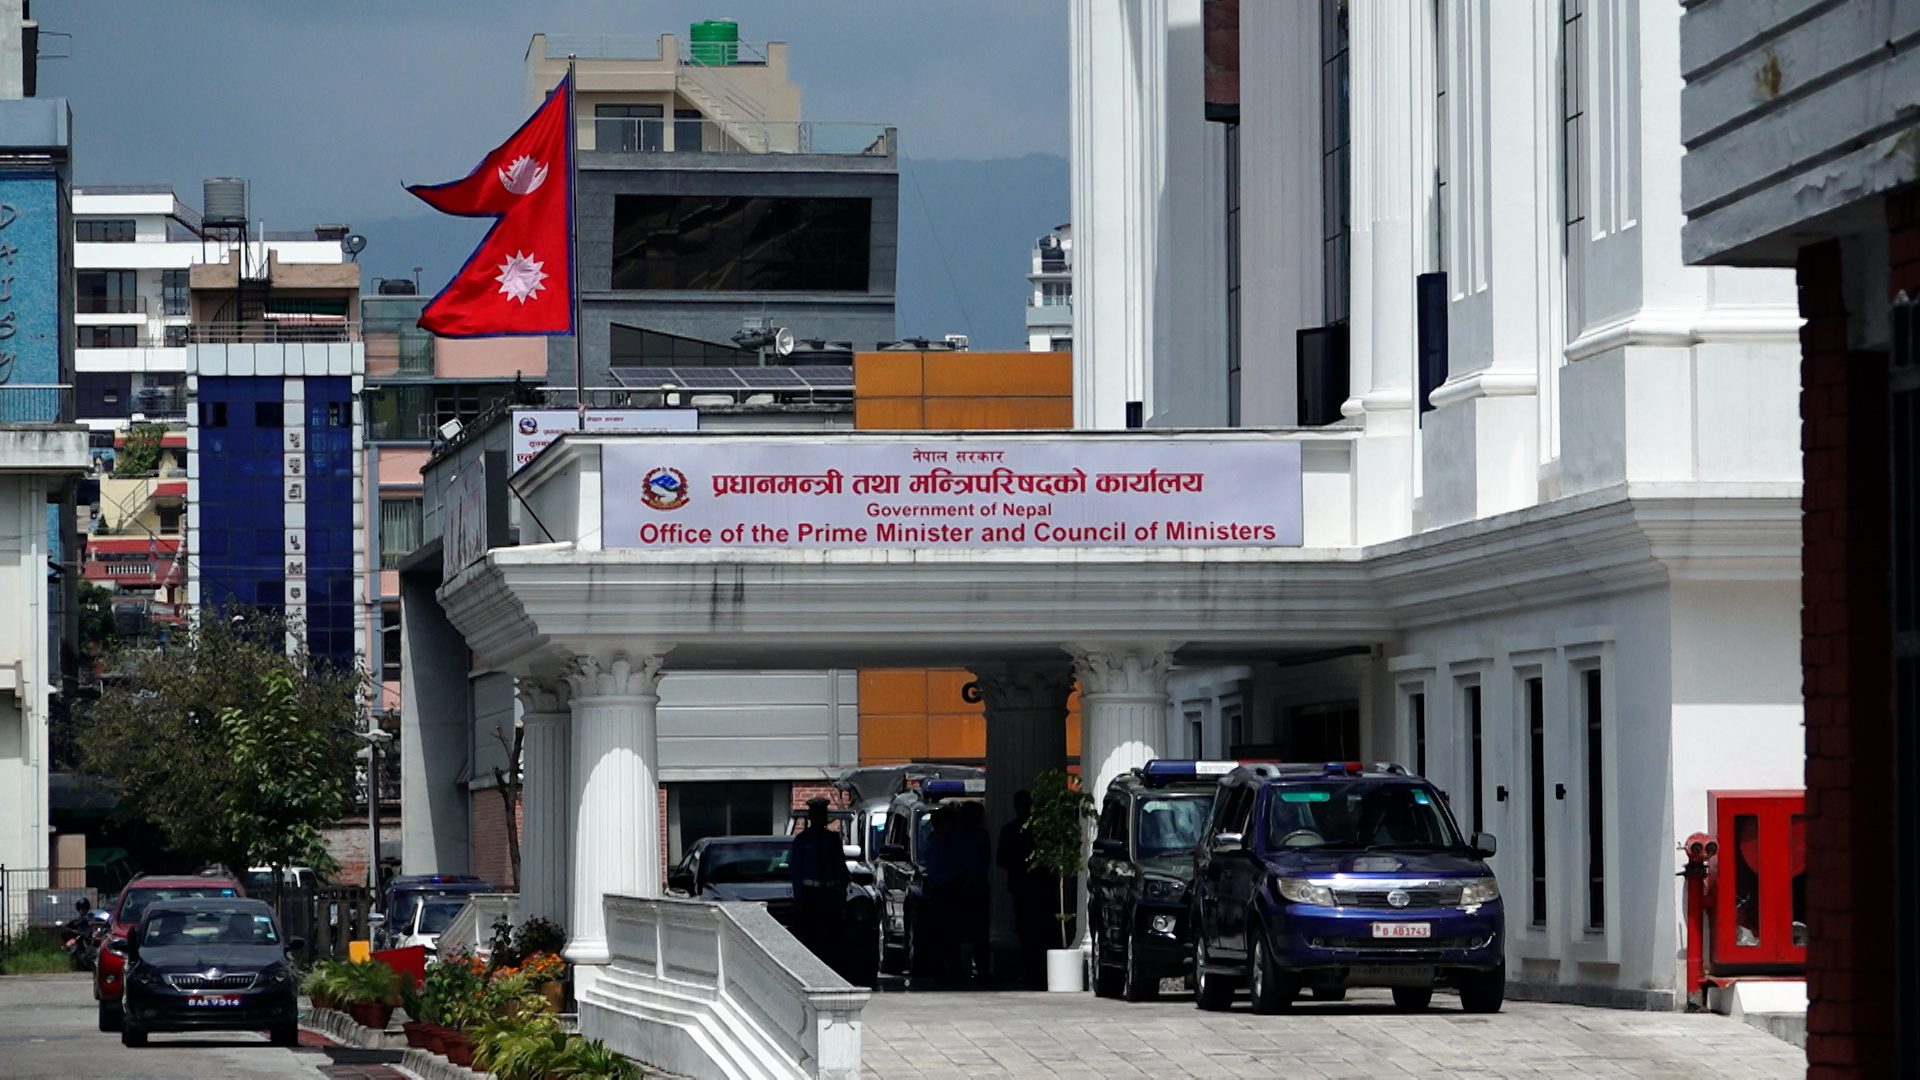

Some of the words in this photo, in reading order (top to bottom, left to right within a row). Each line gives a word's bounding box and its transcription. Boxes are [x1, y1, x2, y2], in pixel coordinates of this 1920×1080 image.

[913, 450, 948, 463] नेपाल
[956, 450, 1005, 463] सरकार
[712, 468, 843, 497] प्रधानमन्त्री
[852, 474, 901, 495] तथा
[1096, 467, 1204, 495] कार्यालय
[867, 502, 975, 517] Government
[981, 503, 997, 516] of
[1002, 503, 1051, 518] Nepal
[640, 523, 711, 545] Office
[720, 523, 745, 544] of
[752, 523, 790, 544] the
[797, 522, 868, 543] Prime
[876, 522, 973, 543] Minister
[980, 523, 1026, 543] and
[1033, 521, 1127, 543] Council
[1133, 521, 1159, 542] of
[1166, 520, 1277, 541] Ministers
